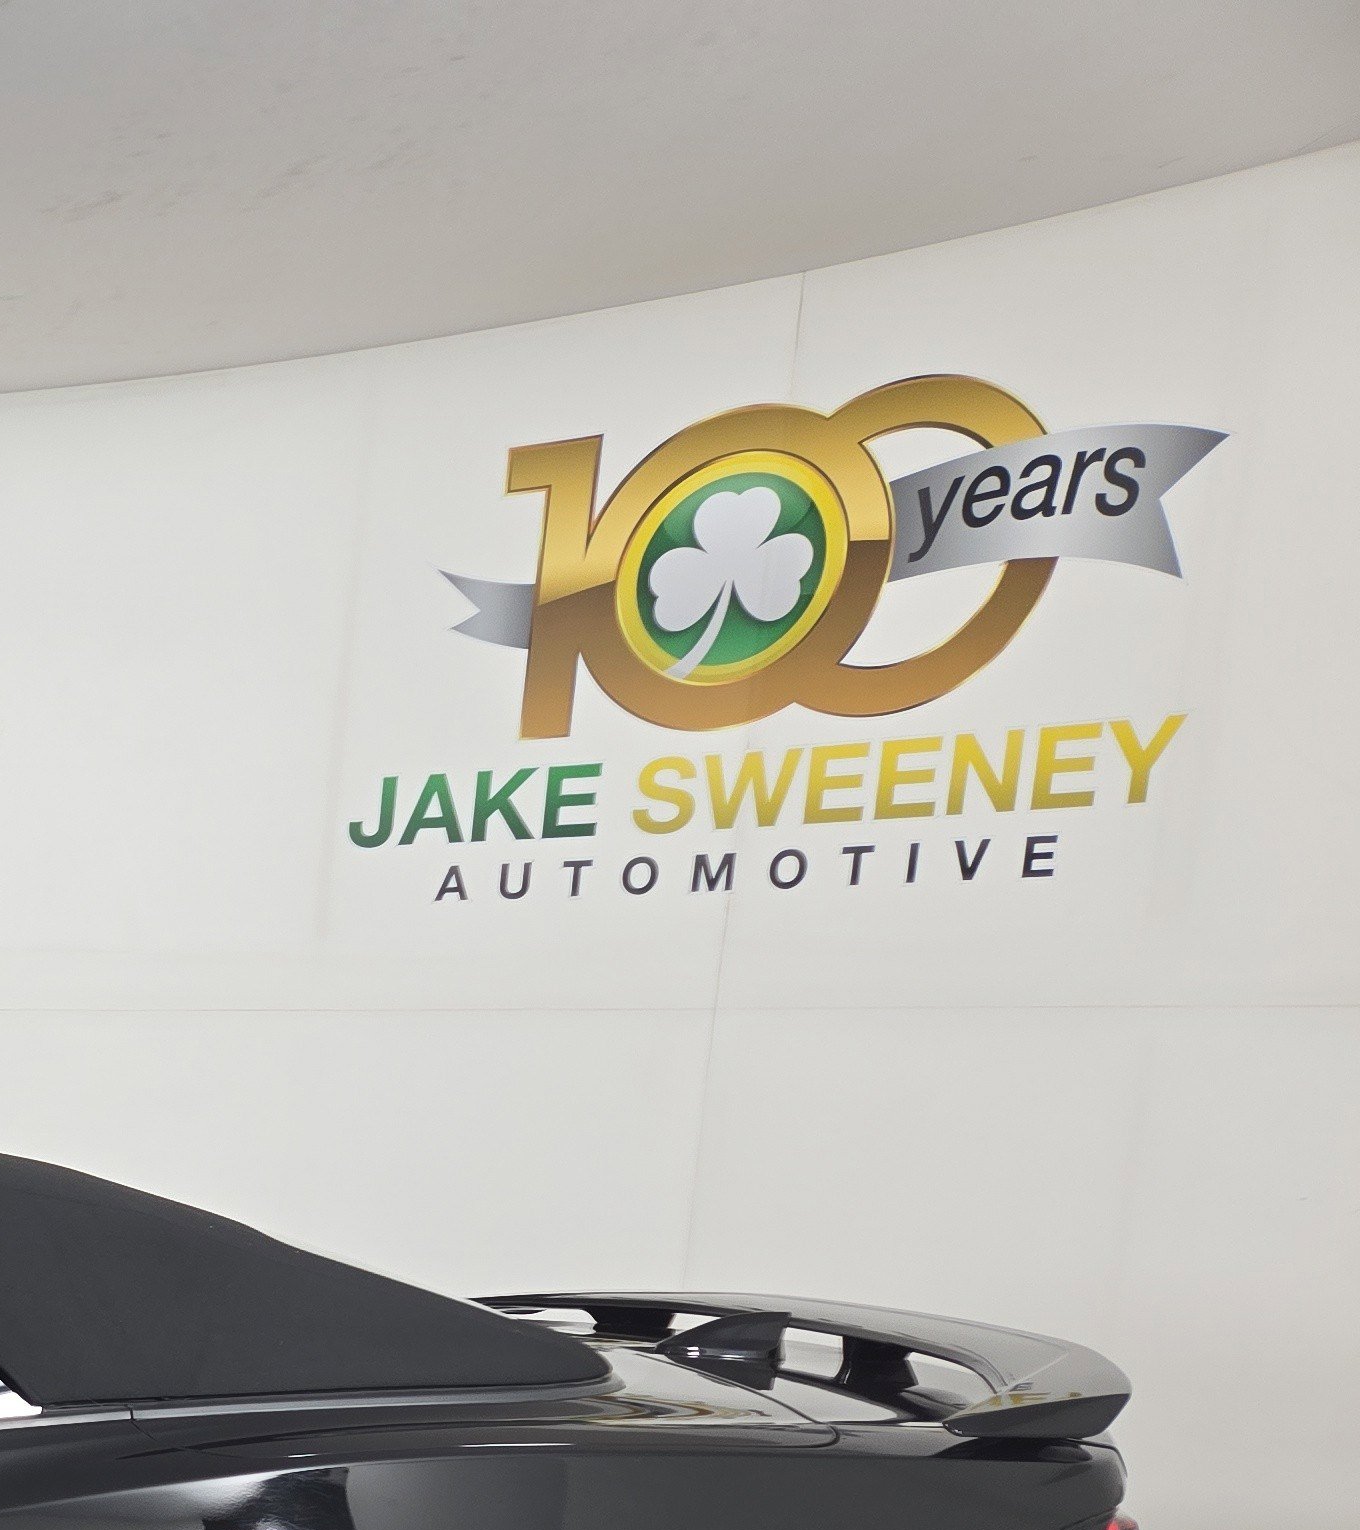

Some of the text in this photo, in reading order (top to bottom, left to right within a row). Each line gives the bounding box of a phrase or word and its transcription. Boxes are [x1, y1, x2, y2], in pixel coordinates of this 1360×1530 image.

[505, 373, 1147, 740] 100 years
[348, 713, 1188, 849] JAKE SWEENEY
[433, 834, 1060, 903] AUTOMOTIVE
